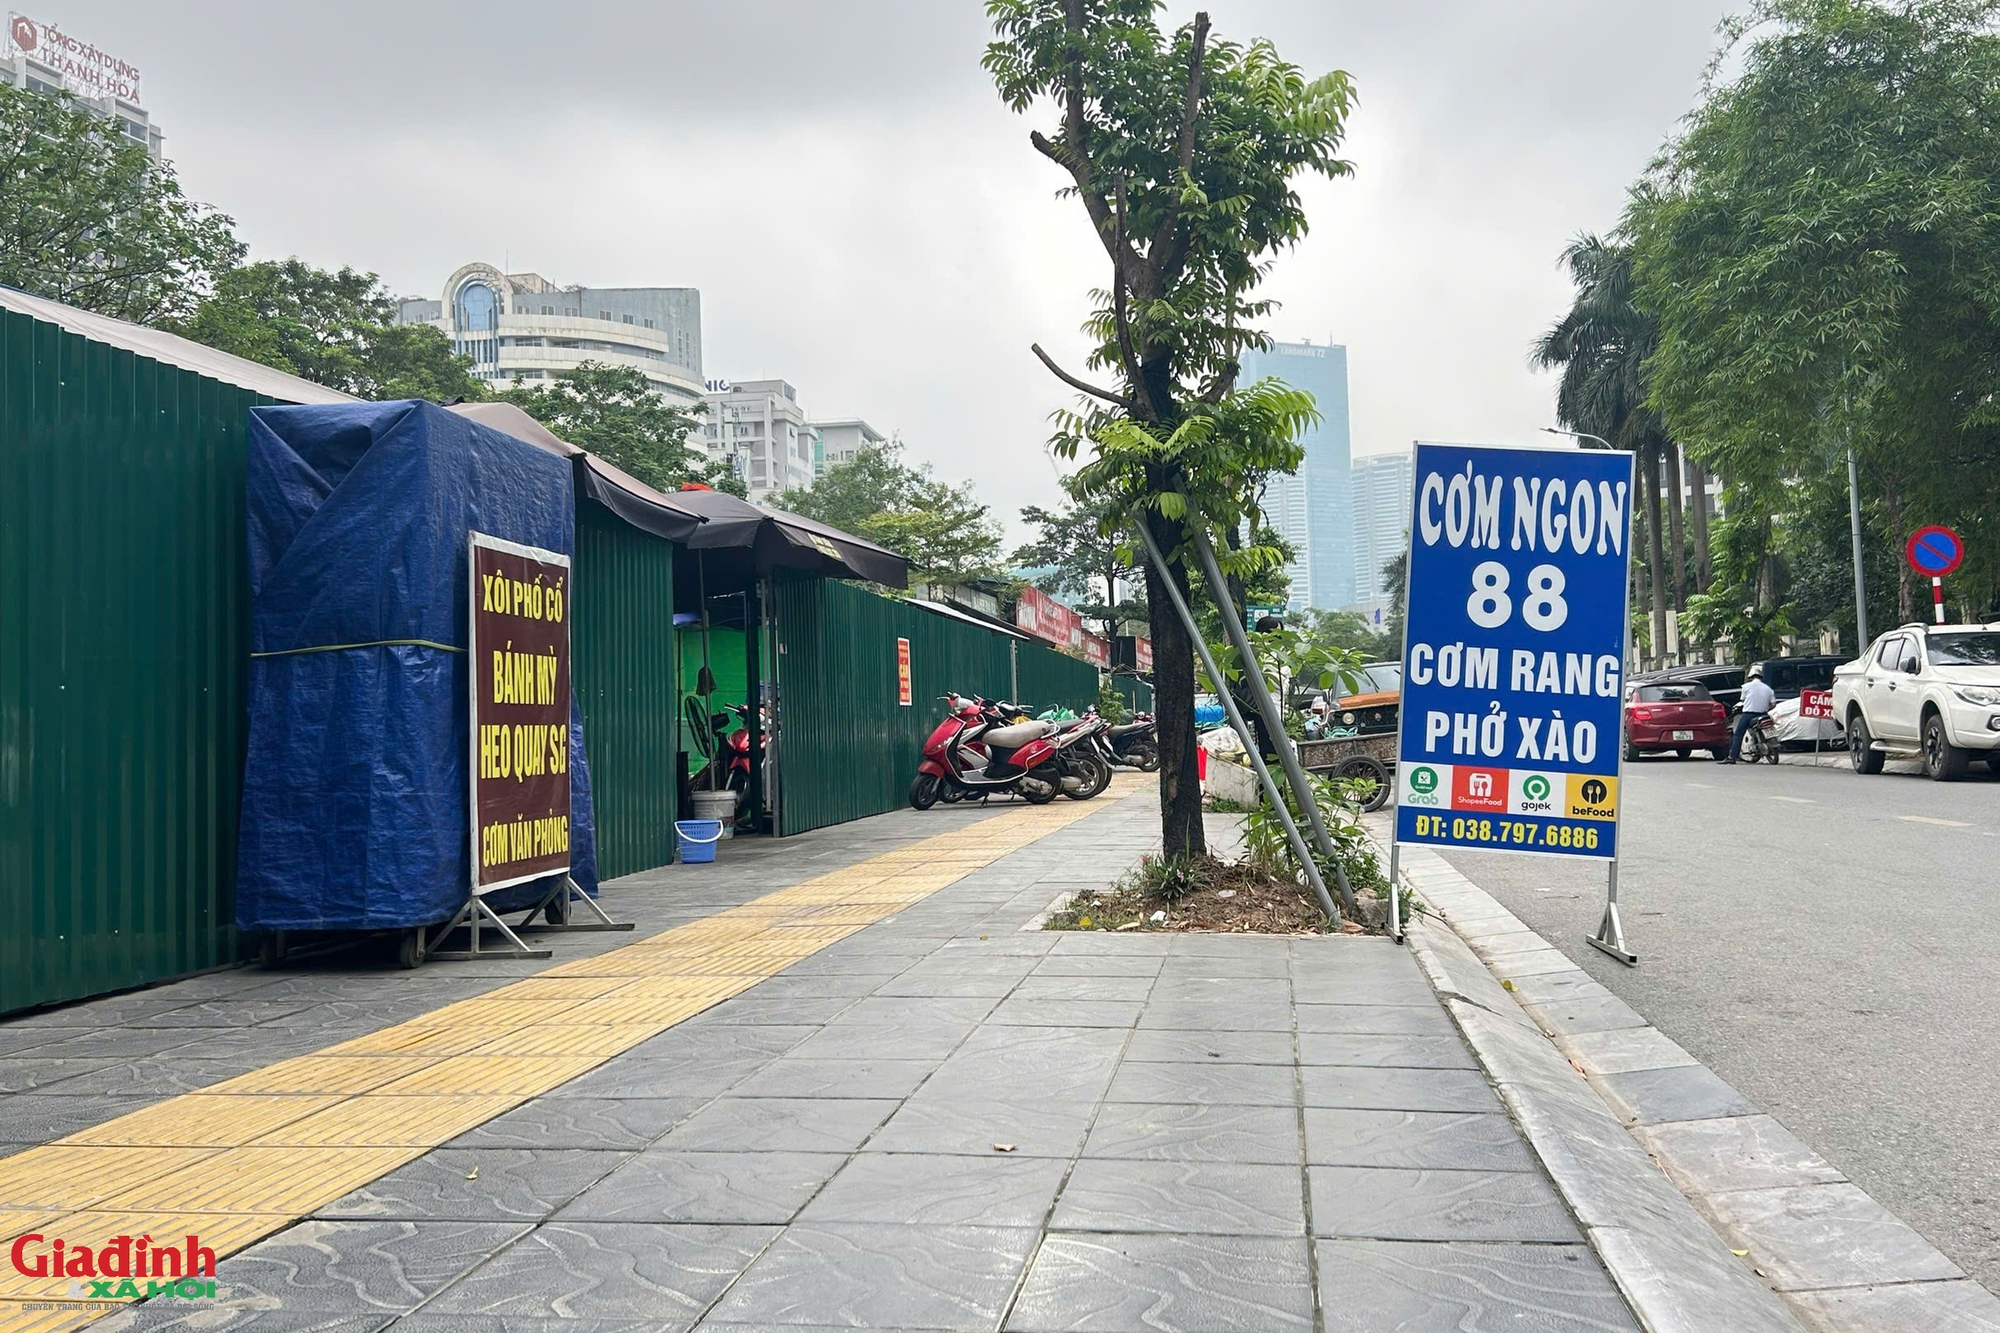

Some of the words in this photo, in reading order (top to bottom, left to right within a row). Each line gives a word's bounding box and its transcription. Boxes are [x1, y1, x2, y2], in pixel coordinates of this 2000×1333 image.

[42, 23, 77, 52] TỔNG
[78, 43, 104, 64] XÂY
[41, 46, 100, 86] THANH
[1419, 459, 1504, 550] CƠM
[1510, 476, 1627, 557] NGON
[482, 569, 511, 614] XÔI
[513, 573, 543, 620] PHỐ
[545, 576, 564, 623] CỔ
[493, 640, 535, 705] BÁNH
[536, 645, 558, 706] MỲ
[1409, 641, 1500, 690] CƠM
[1510, 649, 1620, 698] RANG
[1805, 706, 1820, 716] ĐỖ
[1809, 693, 1833, 706] CẤM
[1425, 700, 1508, 758] PHỞ
[1515, 709, 1597, 765] XÀO
[480, 724, 512, 779] HEO
[513, 724, 549, 783] QUAY
[549, 724, 567, 775] SG
[1408, 793, 1439, 806] Grab
[1457, 795, 1503, 807] ShopeeFood
[1520, 800, 1552, 812] gojek
[1572, 805, 1615, 818] beFood
[482, 821, 508, 868] CƠM
[509, 813, 533, 862] VĂN
[1416, 814, 1447, 838] ĐT:
[1452, 818, 1599, 849] 038.797.6886
